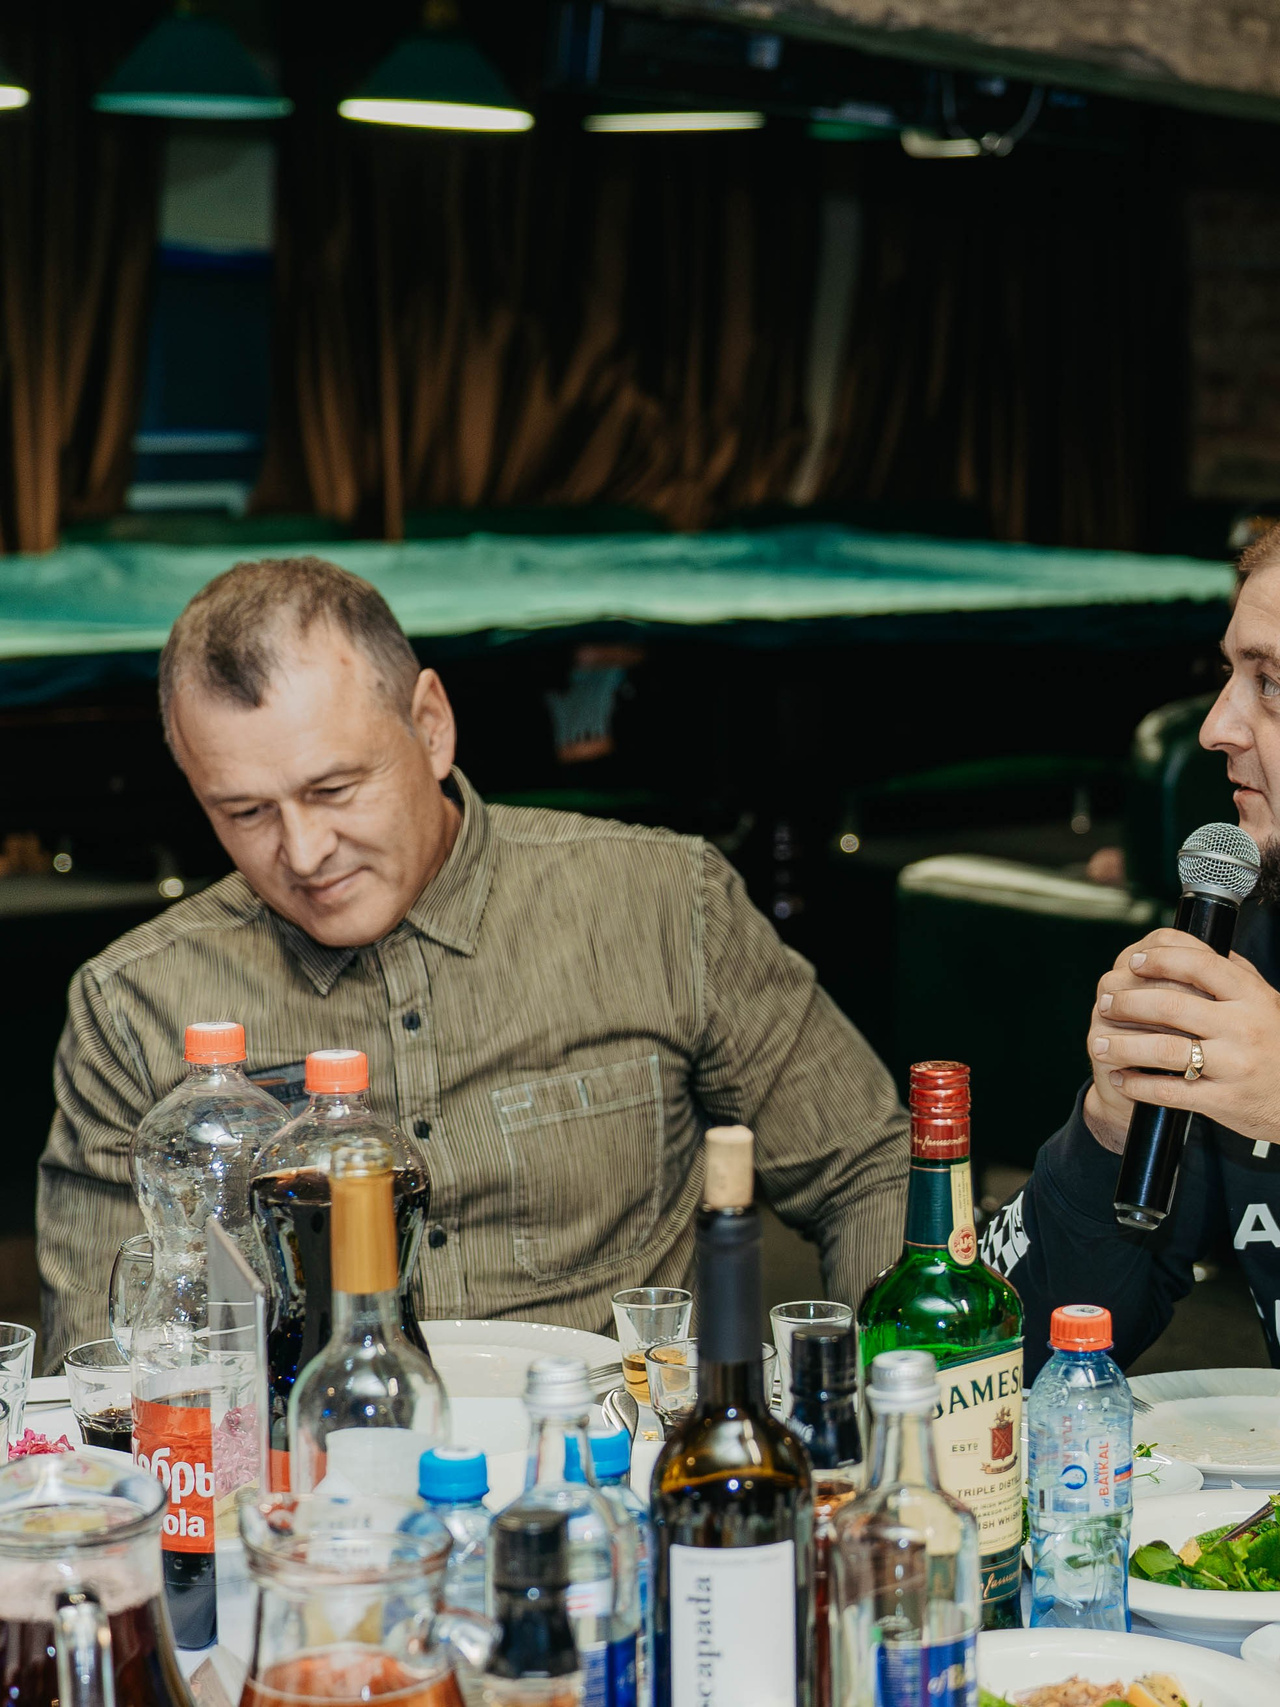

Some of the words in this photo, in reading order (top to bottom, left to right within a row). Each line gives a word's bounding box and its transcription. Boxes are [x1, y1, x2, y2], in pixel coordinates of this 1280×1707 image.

[932, 1364, 1022, 1421] JAMES
[1098, 1440, 1110, 1497] BAIKAL
[957, 1483, 996, 1499] TRIPLE
[162, 1508, 205, 1537] ola
